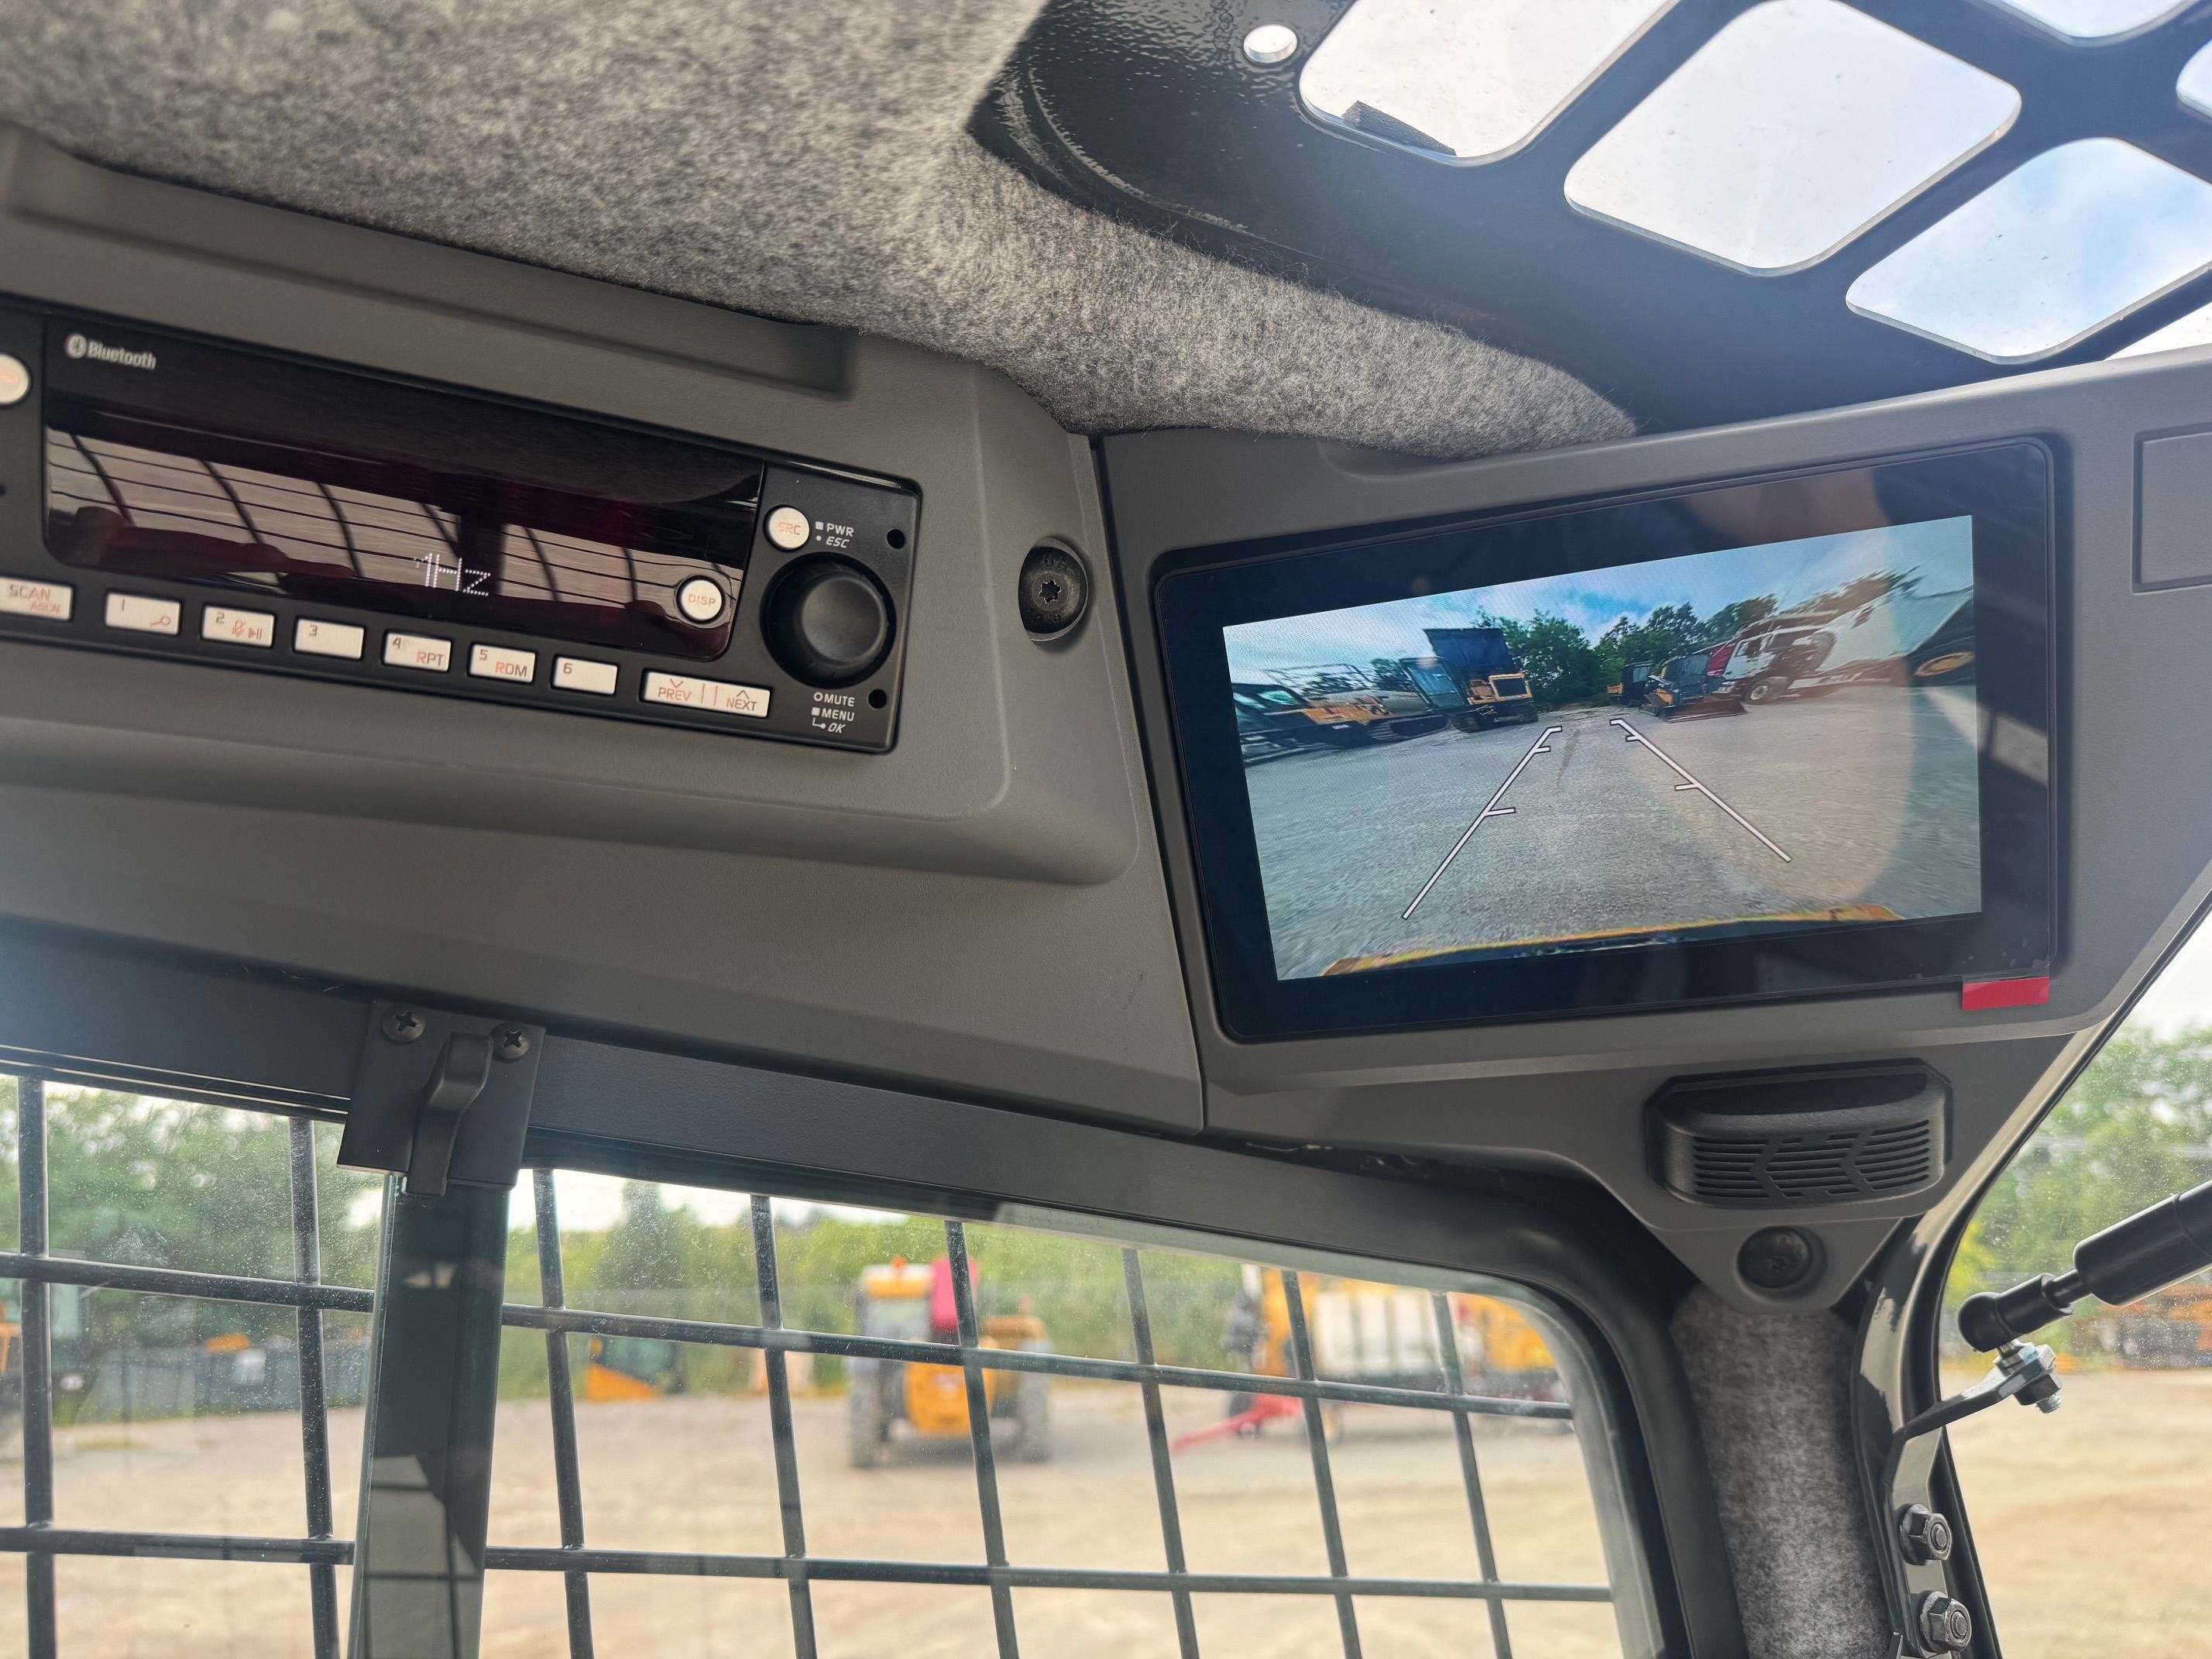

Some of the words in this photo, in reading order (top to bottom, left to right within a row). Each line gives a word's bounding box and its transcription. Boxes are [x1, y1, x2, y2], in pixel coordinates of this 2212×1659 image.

[87, 340, 156, 369] Bluetooth
[778, 521, 801, 535] SRC
[826, 523, 854, 537] PWR
[826, 536, 850, 548] ESC
[8, 583, 51, 601] SCAN
[688, 593, 716, 606] DISP
[215, 611, 225, 623] 2
[308, 625, 318, 637] 3
[393, 637, 402, 649] 4
[416, 651, 445, 667] RPT
[479, 649, 489, 661] 5
[495, 661, 528, 678] RDM
[563, 663, 572, 675] 6
[658, 686, 692, 702] PREV
[824, 692, 855, 707] MUTE
[726, 697, 757, 712] NEXT
[821, 707, 855, 722] MENU
[828, 722, 847, 733] OK
